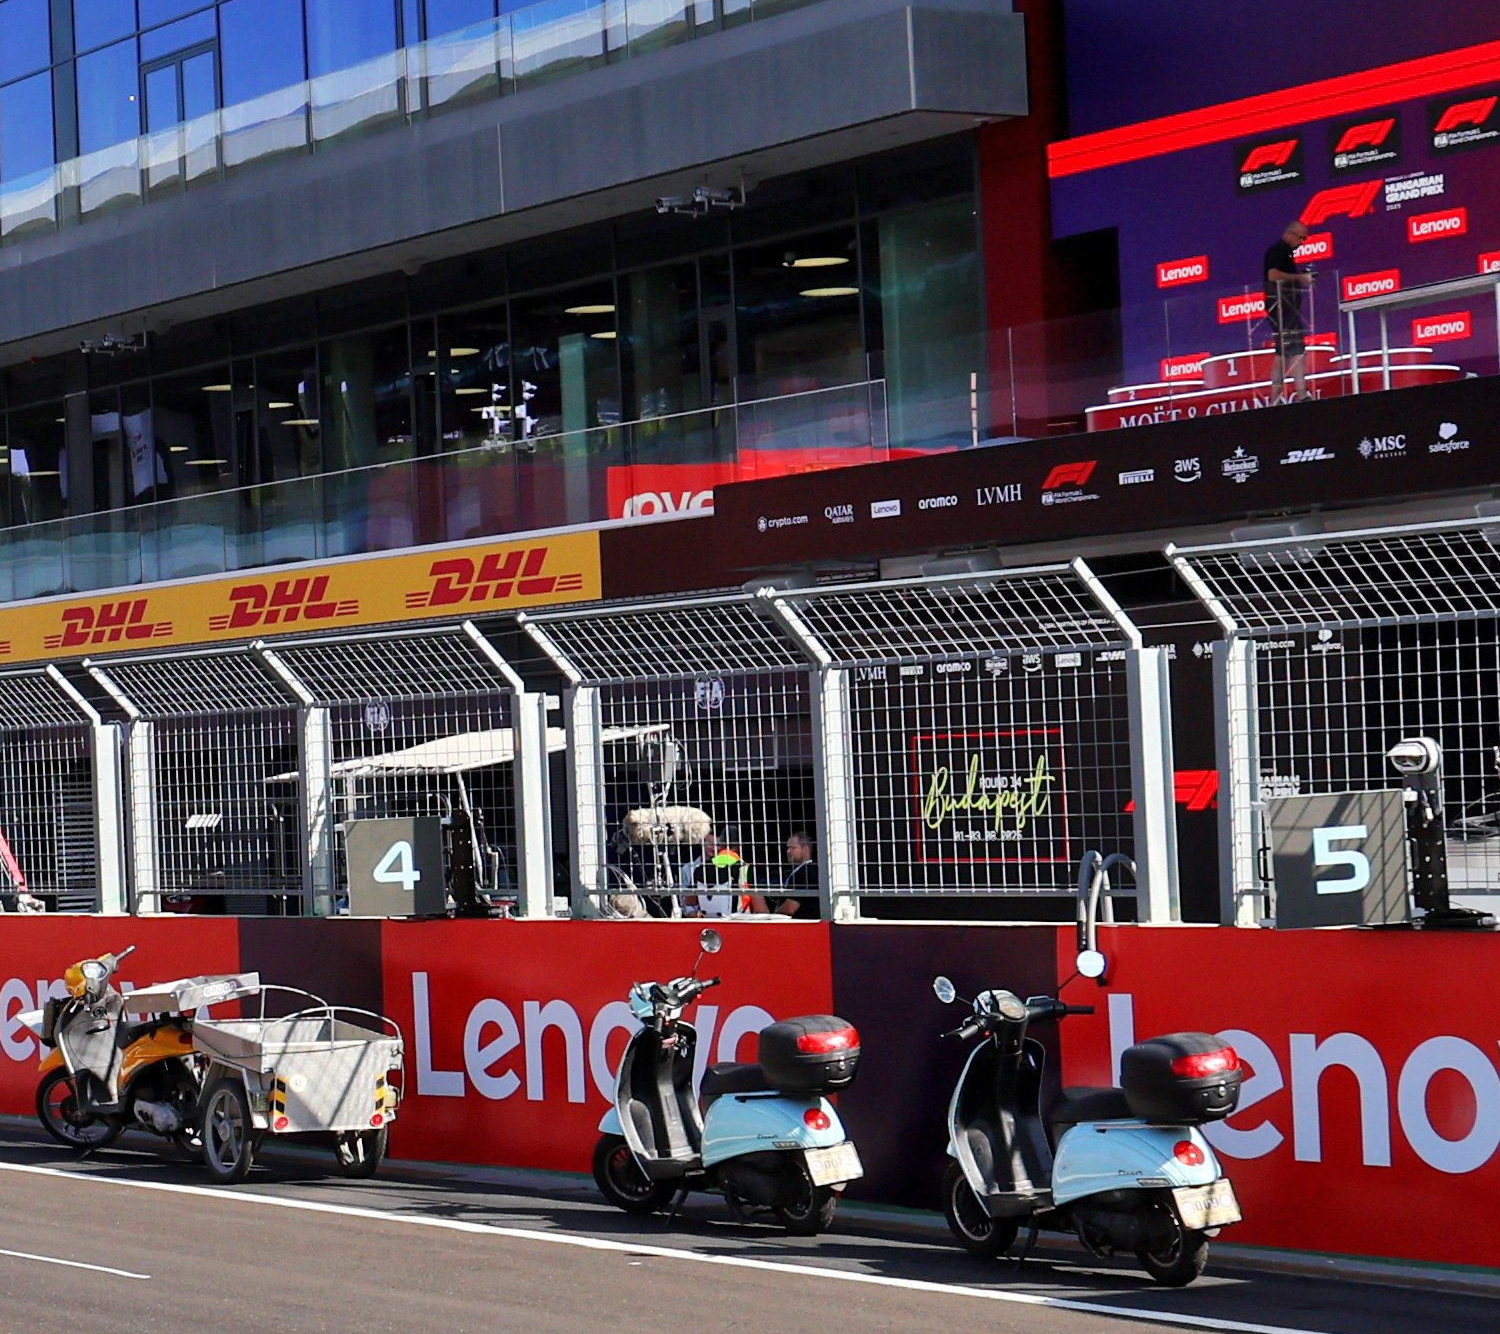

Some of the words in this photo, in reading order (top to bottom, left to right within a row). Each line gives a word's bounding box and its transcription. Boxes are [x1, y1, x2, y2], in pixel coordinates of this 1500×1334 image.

[1384, 174, 1444, 194] HUNGARIAN
[1385, 188, 1420, 204] GRAND
[1420, 184, 1445, 198] PRIX
[1412, 214, 1461, 236] Lenovo
[1292, 238, 1327, 258] novo
[1160, 262, 1203, 281] Lenovo
[1347, 273, 1394, 296] Lenovo
[1221, 297, 1266, 318] Lenovo
[1416, 317, 1465, 339] Lenovo
[1227, 359, 1238, 377] 1
[1206, 388, 1322, 416] CHANON
[1374, 434, 1406, 452] MSC
[1428, 438, 1470, 454] salesforce
[1174, 457, 1200, 473] aws
[1286, 447, 1327, 463] DHL
[1118, 469, 1154, 485] PIRELLI
[918, 495, 958, 510] aramco
[976, 483, 1022, 506] LVMH
[824, 504, 854, 518] QATAR
[873, 503, 898, 515] Lenovo
[768, 514, 809, 529] crypto.com
[427, 548, 558, 607] DHL
[228, 576, 340, 630] DHL
[62, 598, 154, 647] DHL
[936, 661, 971, 673] aramco
[1022, 653, 1041, 665] aws
[855, 666, 887, 682] LVMH
[924, 753, 1056, 833] Budapest
[372, 841, 420, 891] 4
[1312, 825, 1371, 895] 5
